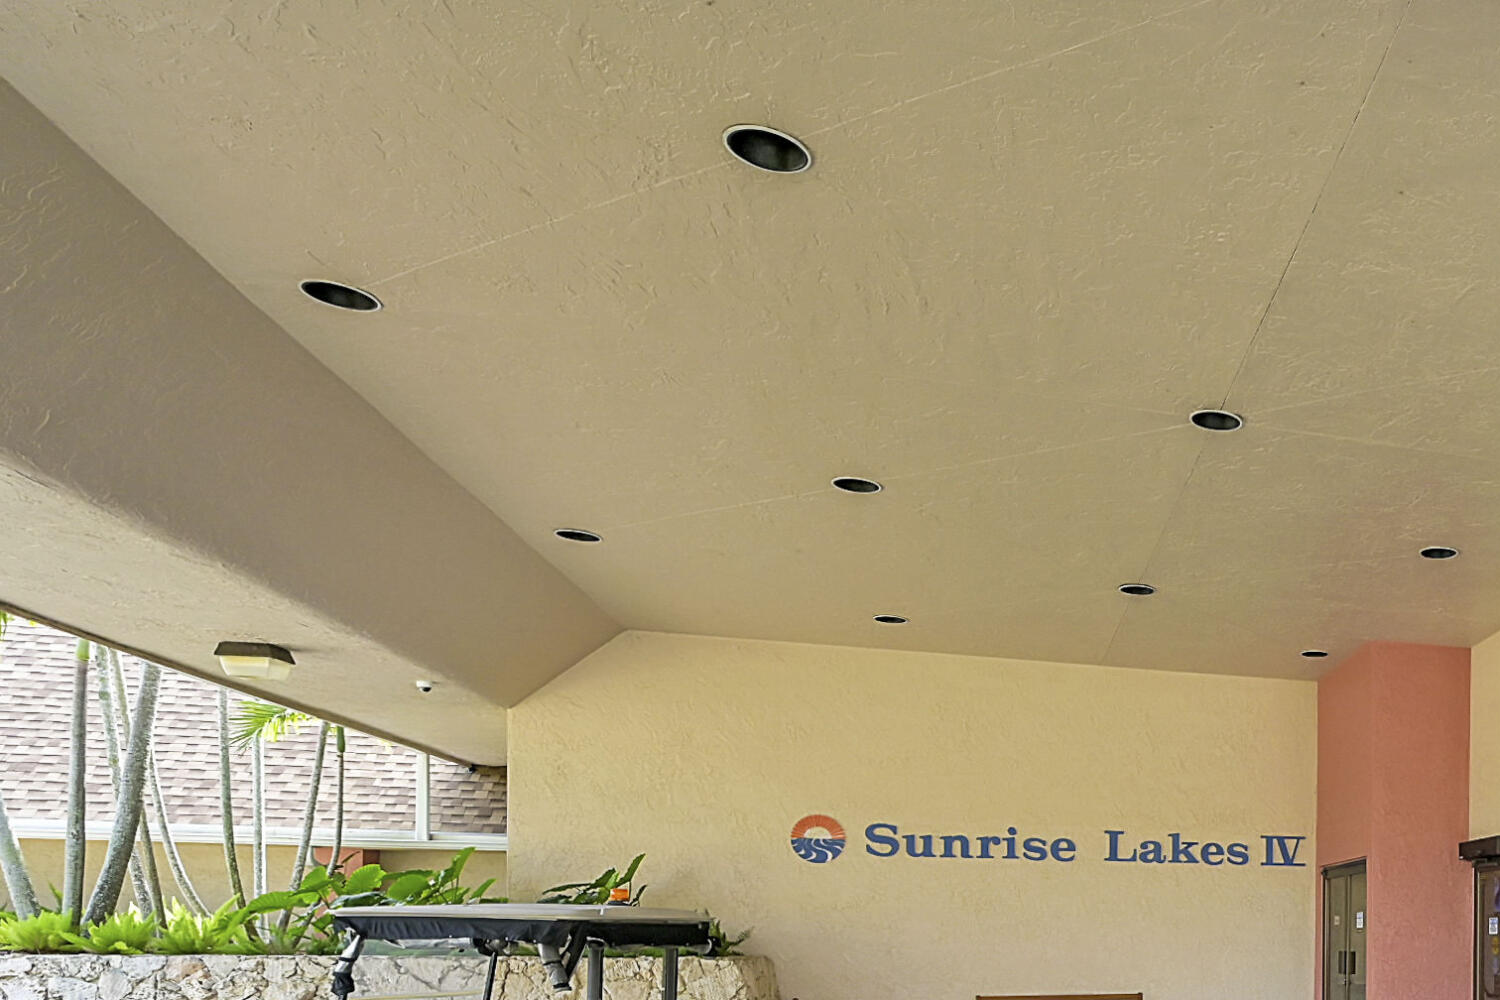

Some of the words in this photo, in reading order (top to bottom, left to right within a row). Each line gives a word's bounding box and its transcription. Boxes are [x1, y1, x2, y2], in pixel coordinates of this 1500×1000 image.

[864, 822, 1077, 862] Sunrise
[1103, 829, 1250, 866] Lakes
[1259, 834, 1307, 867] IV
